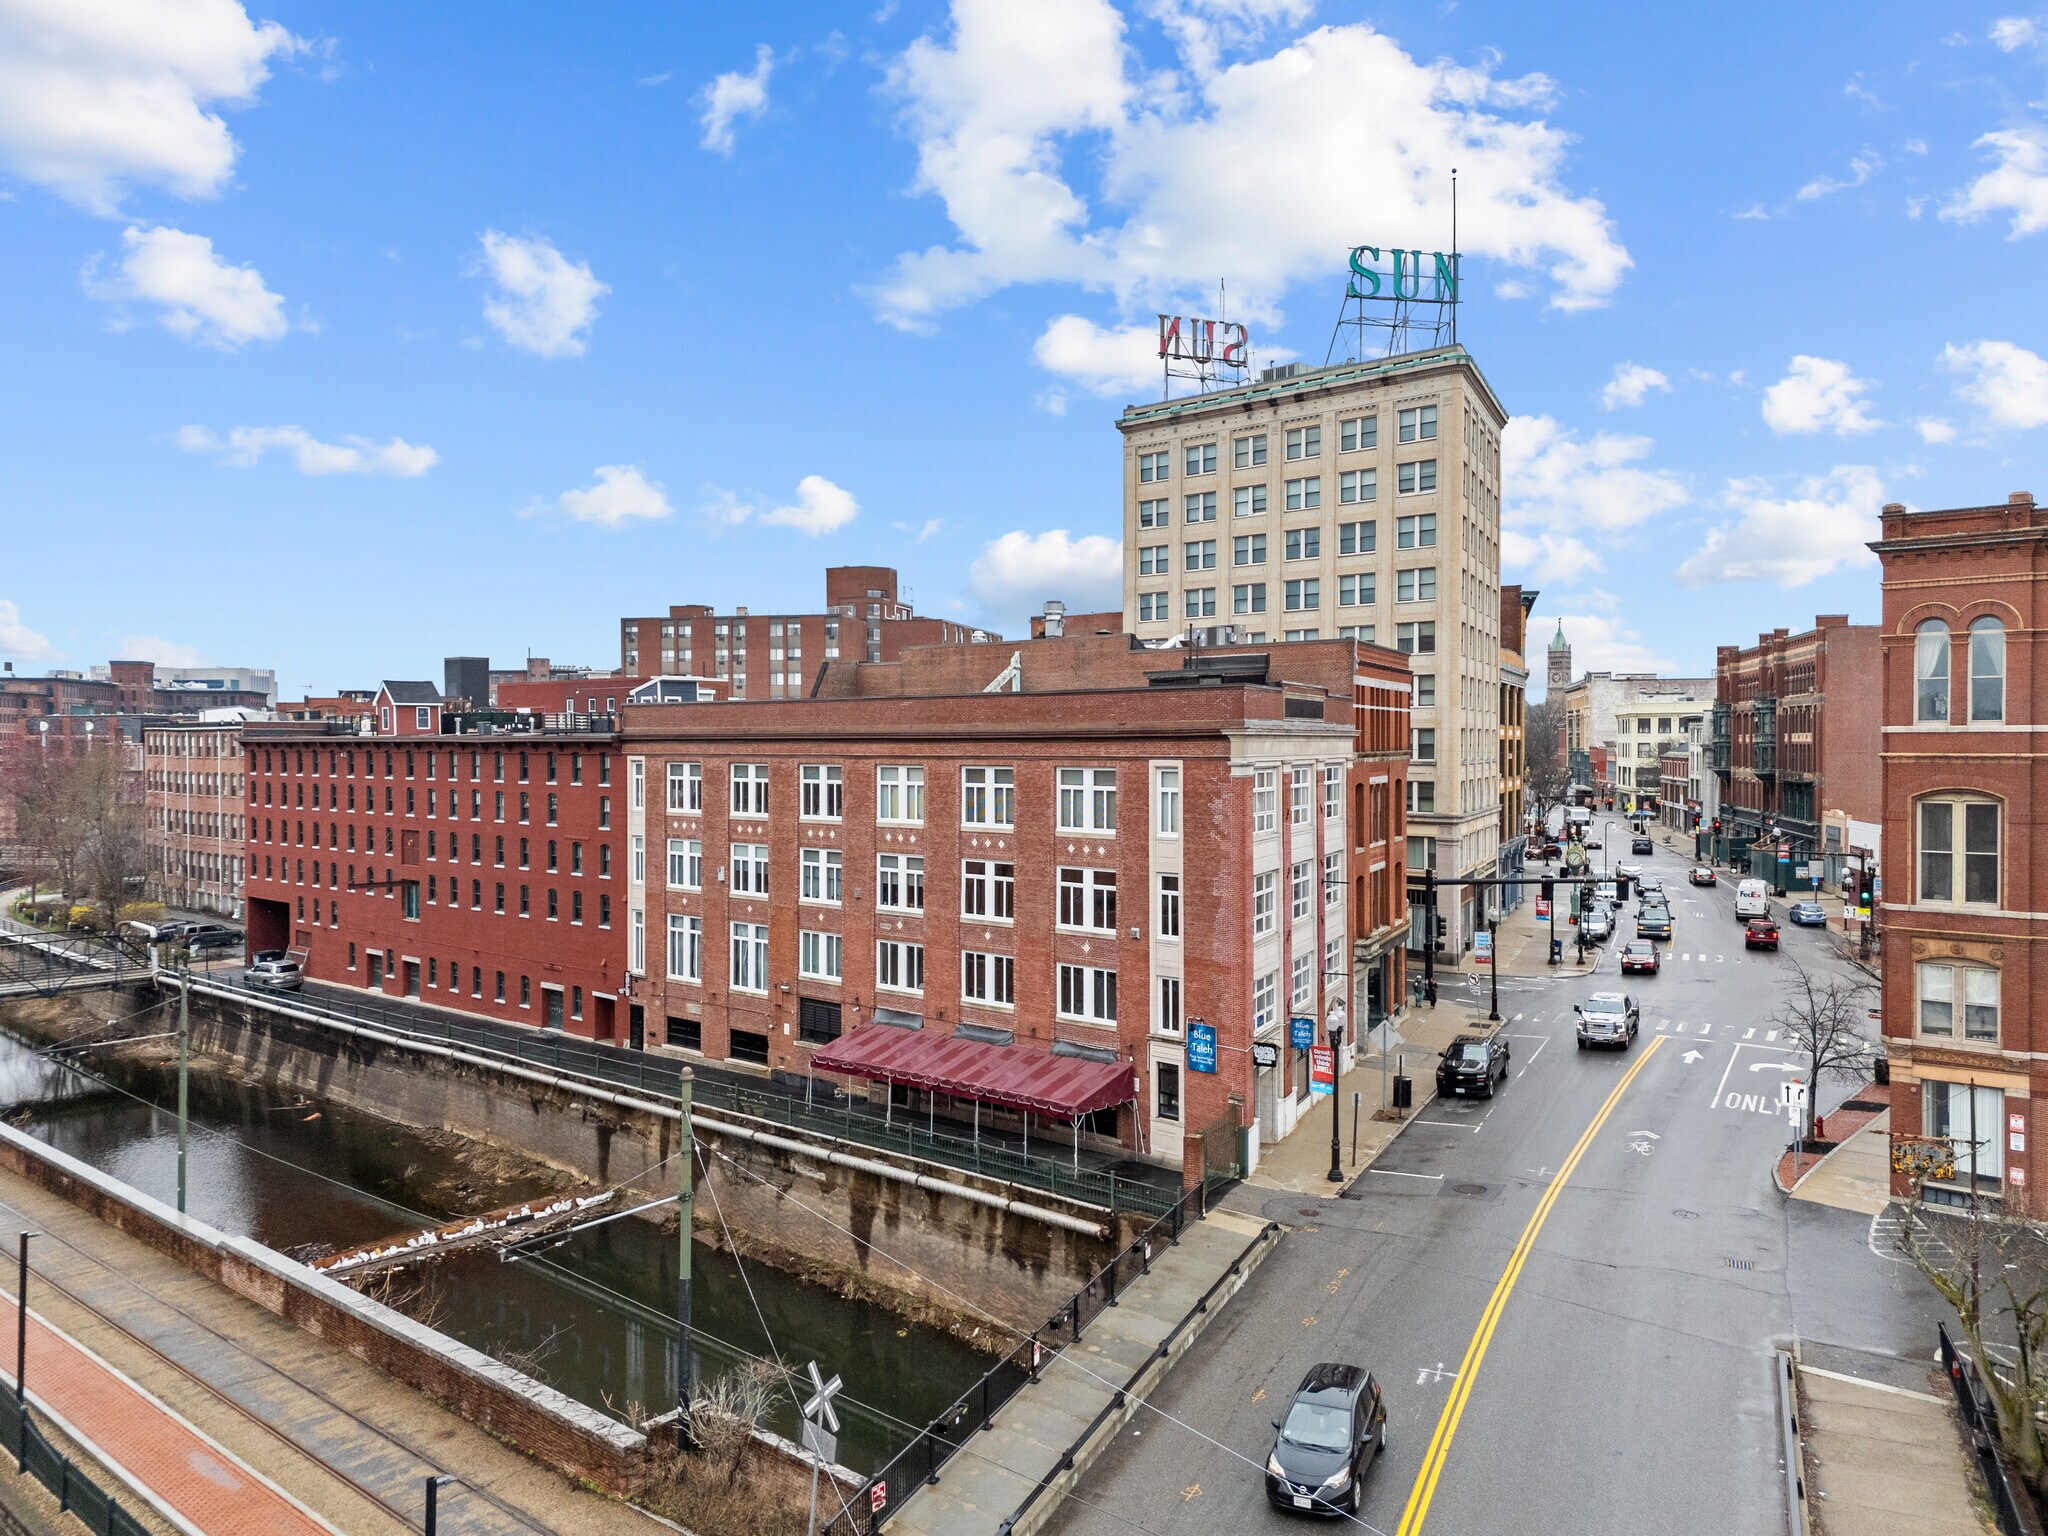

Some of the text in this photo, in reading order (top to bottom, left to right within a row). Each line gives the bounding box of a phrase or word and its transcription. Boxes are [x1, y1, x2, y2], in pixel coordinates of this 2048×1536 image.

[1347, 245, 1462, 304] SUN
[1740, 890, 1761, 898] FedEx
[1295, 1021, 1310, 1029] Blue
[1193, 1029, 1211, 1041] Blue
[1725, 1092, 1782, 1116] ONLY
